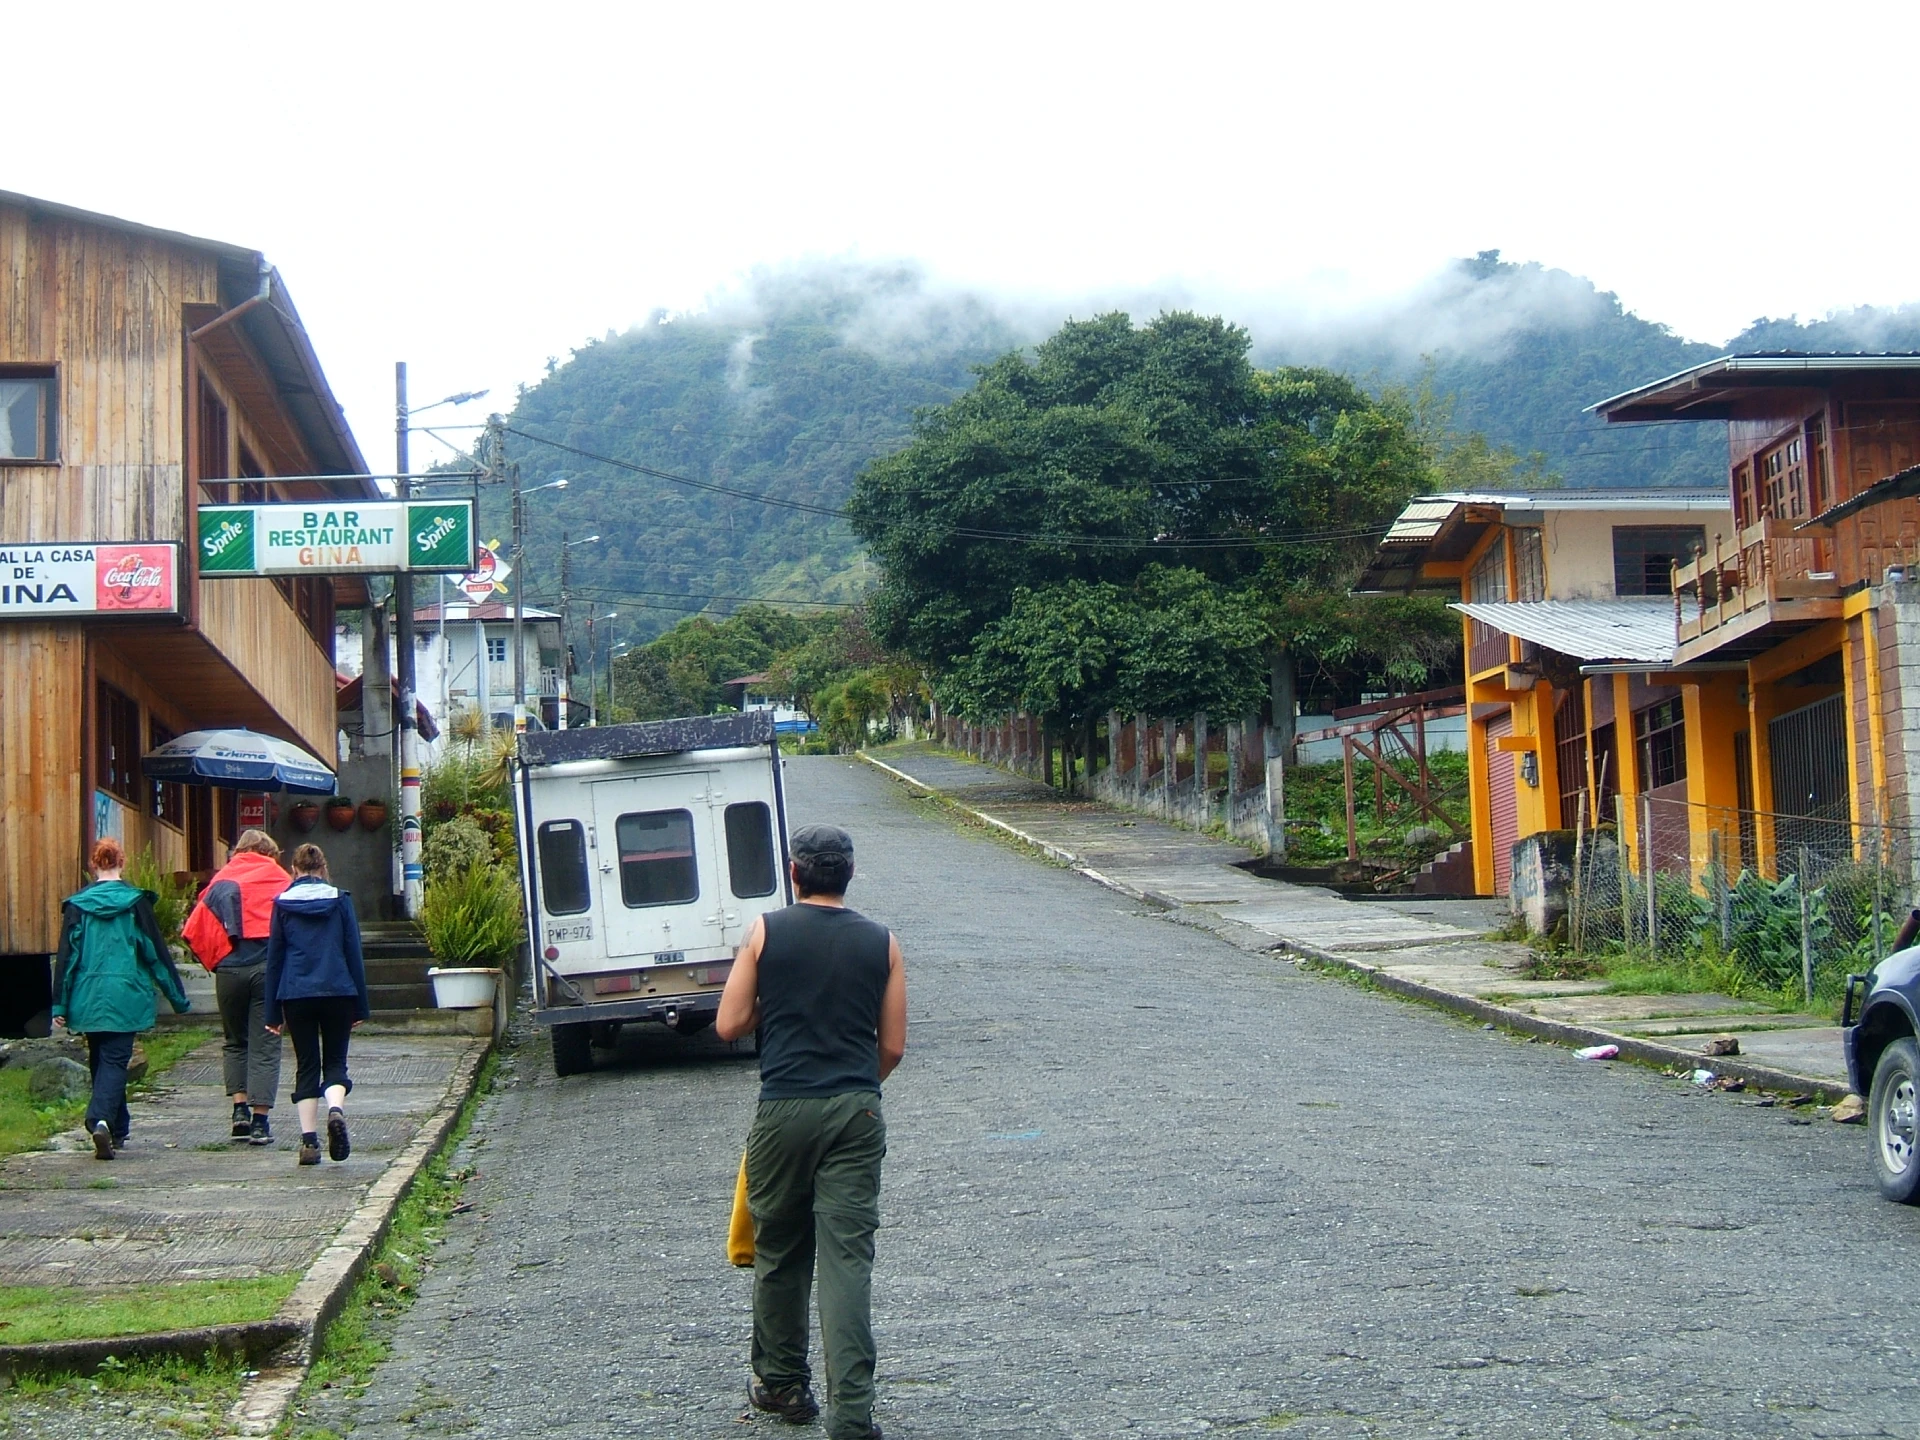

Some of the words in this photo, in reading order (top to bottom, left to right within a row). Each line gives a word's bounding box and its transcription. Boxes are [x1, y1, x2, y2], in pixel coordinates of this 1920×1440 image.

[303, 511, 359, 528] BAR
[203, 521, 243, 557] Sprite
[268, 528, 394, 547] RESTAURANT
[416, 516, 457, 552] Sprite
[24, 550, 45, 563] LA
[51, 550, 95, 562] CASA
[298, 546, 363, 566] GINA
[13, 567, 35, 579] DE
[103, 566, 164, 588] Coca-Cola
[2, 584, 79, 604] INA
[548, 925, 591, 942] PWP-972
